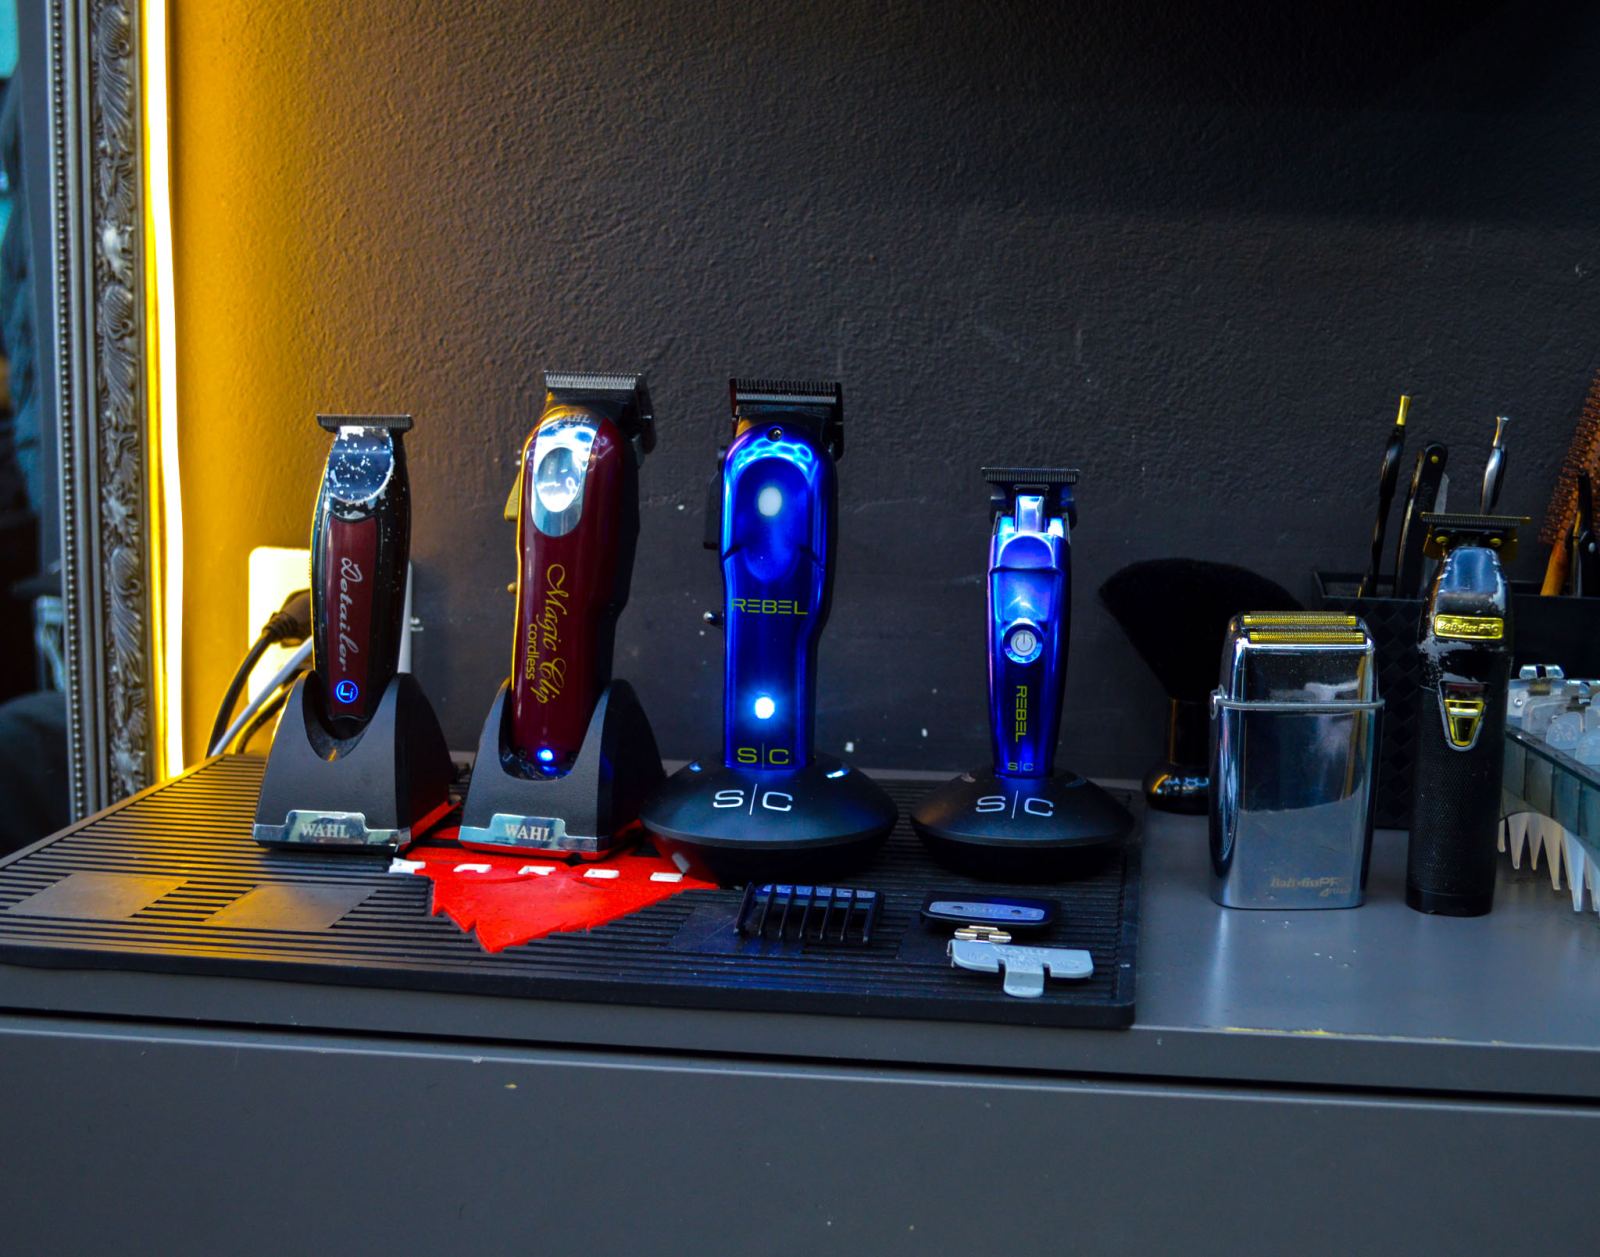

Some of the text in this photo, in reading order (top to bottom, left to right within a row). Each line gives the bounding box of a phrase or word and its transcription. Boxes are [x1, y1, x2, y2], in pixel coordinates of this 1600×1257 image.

[338, 557, 363, 672] Detailer
[530, 563, 569, 704] Magic Clip
[731, 598, 809, 615] REBEL
[525, 623, 540, 680] cordless
[1015, 685, 1028, 743] REBEL
[300, 823, 350, 839] WAHL
[505, 824, 553, 842] WAHL
